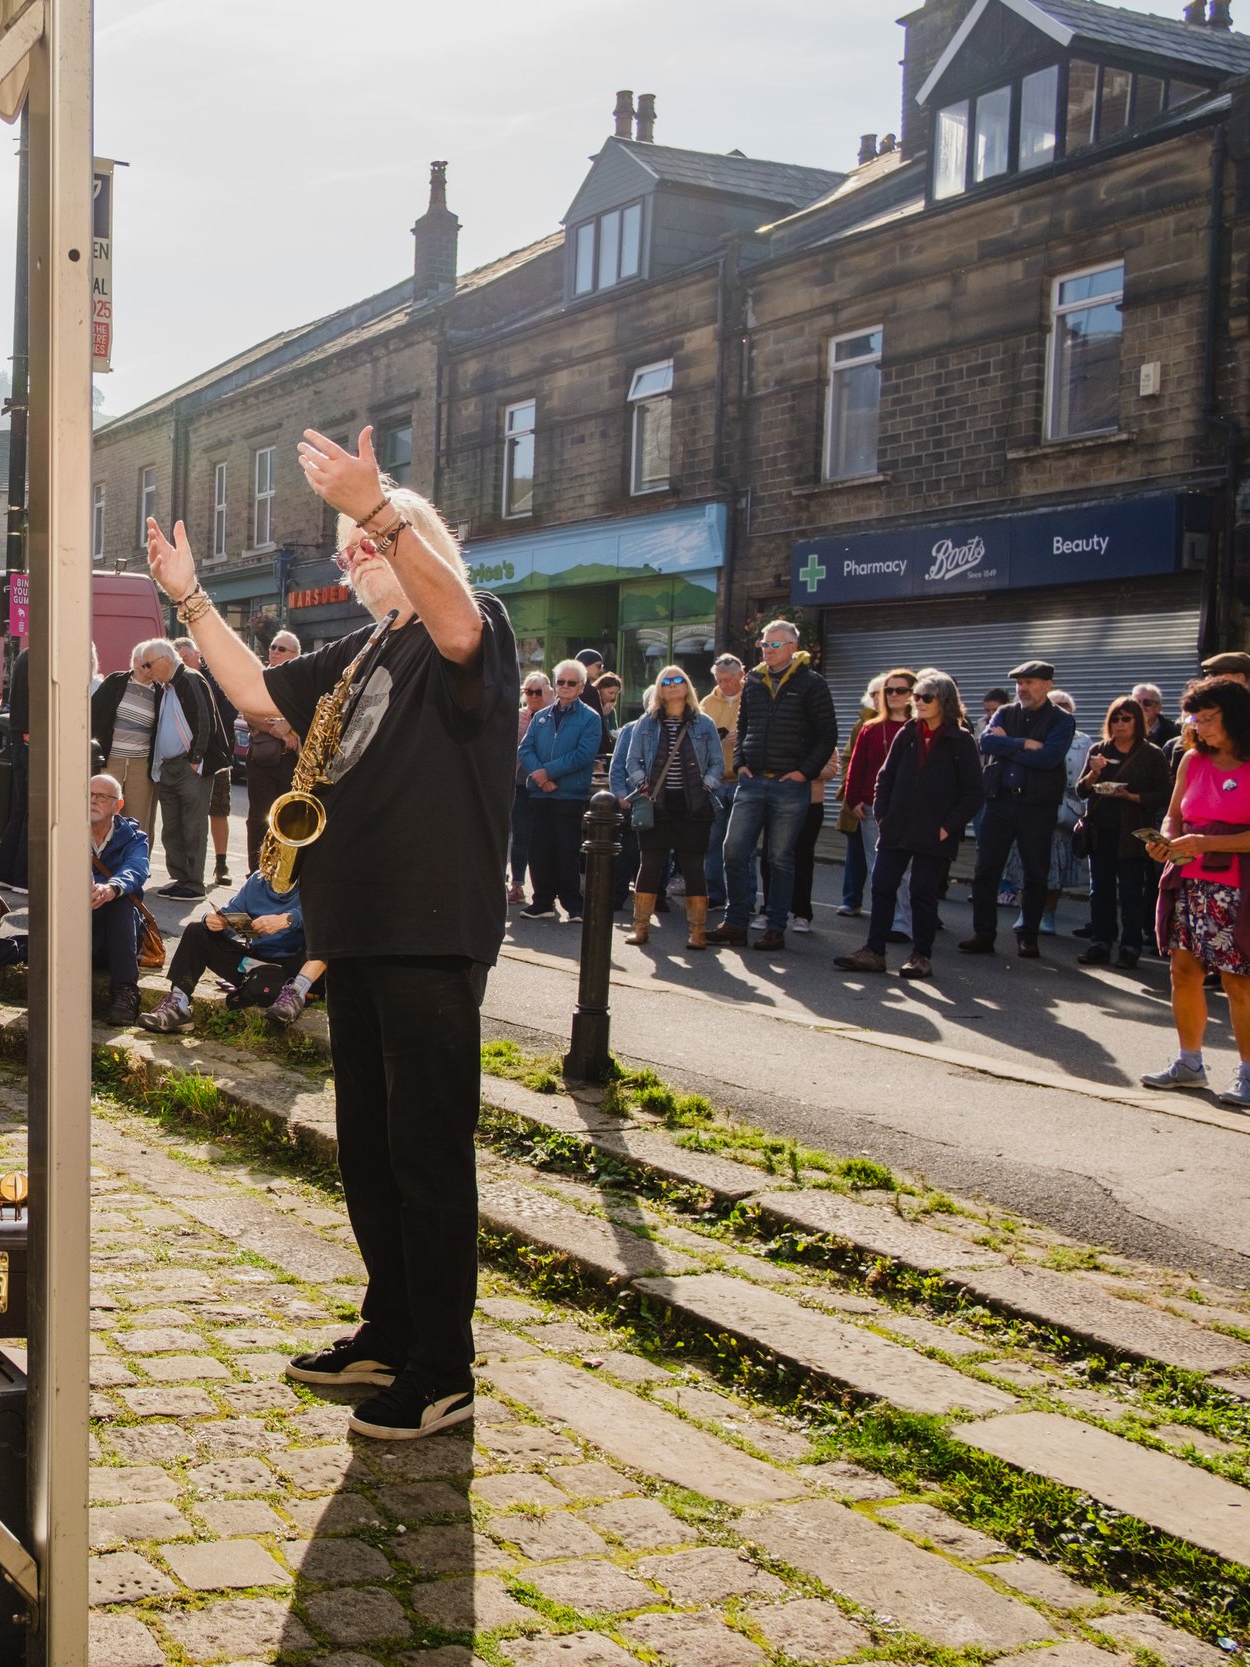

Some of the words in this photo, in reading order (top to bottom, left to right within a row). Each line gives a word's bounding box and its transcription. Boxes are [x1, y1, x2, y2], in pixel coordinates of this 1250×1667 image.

[93, 242, 109, 259] EN
[93, 278, 107, 295] AL
[93, 300, 112, 319] 25
[843, 559, 907, 577] Pharmacy
[925, 536, 985, 580] Boots
[1053, 534, 1109, 555] Beauty
[16, 578, 29, 588] BIN
[967, 570, 982, 580] Since
[13, 586, 29, 597] YOU
[13, 595, 29, 605] GUM
[288, 584, 349, 609] MARSDEN
